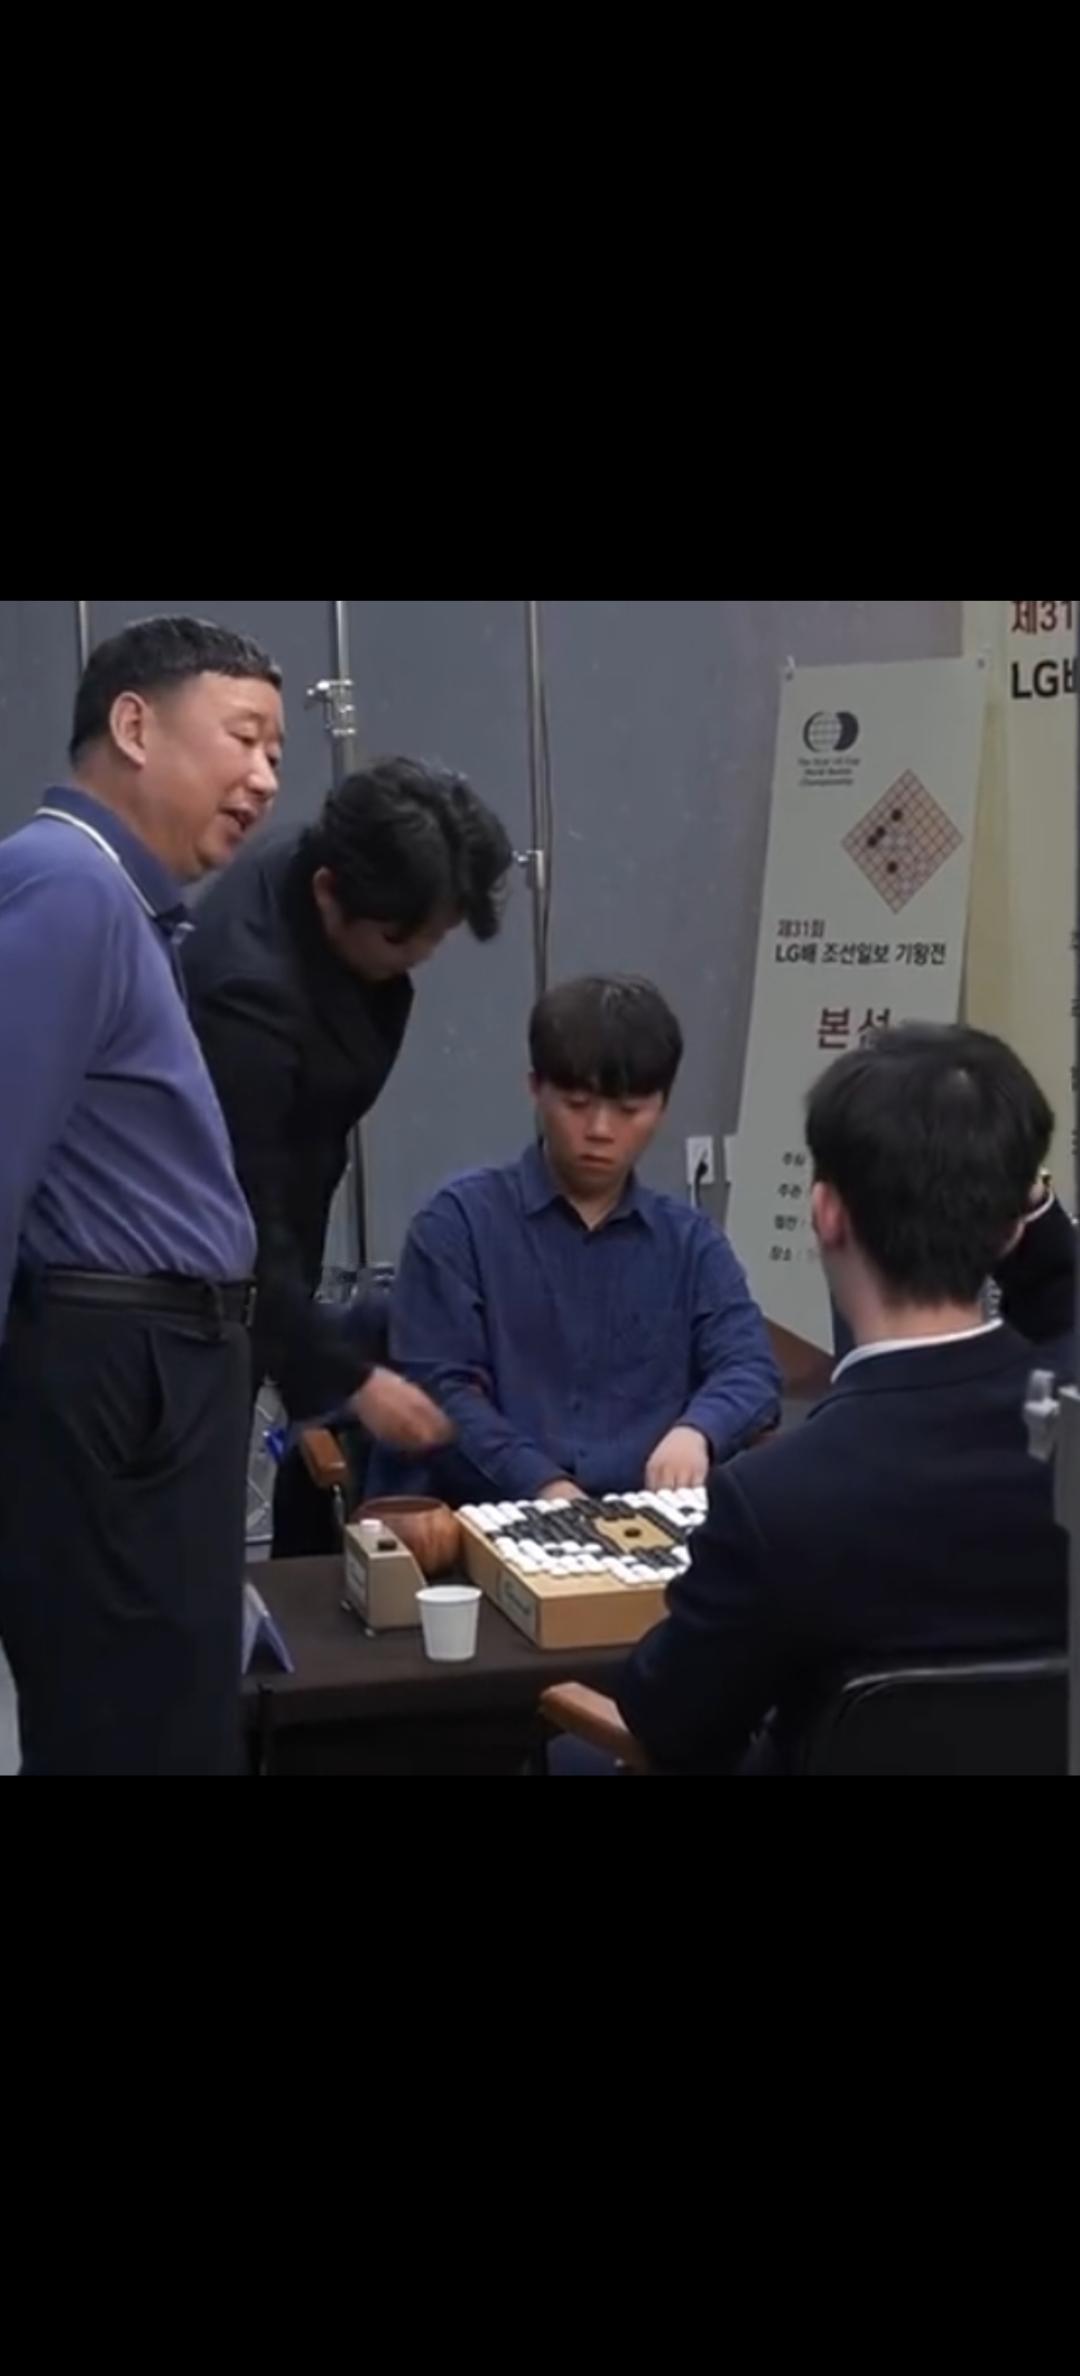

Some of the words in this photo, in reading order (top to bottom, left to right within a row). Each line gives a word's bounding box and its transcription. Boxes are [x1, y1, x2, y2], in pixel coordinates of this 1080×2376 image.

[777, 919, 825, 938] 제31회
[821, 942, 890, 965] 조선일보
[895, 942, 947, 965] 기왕전
